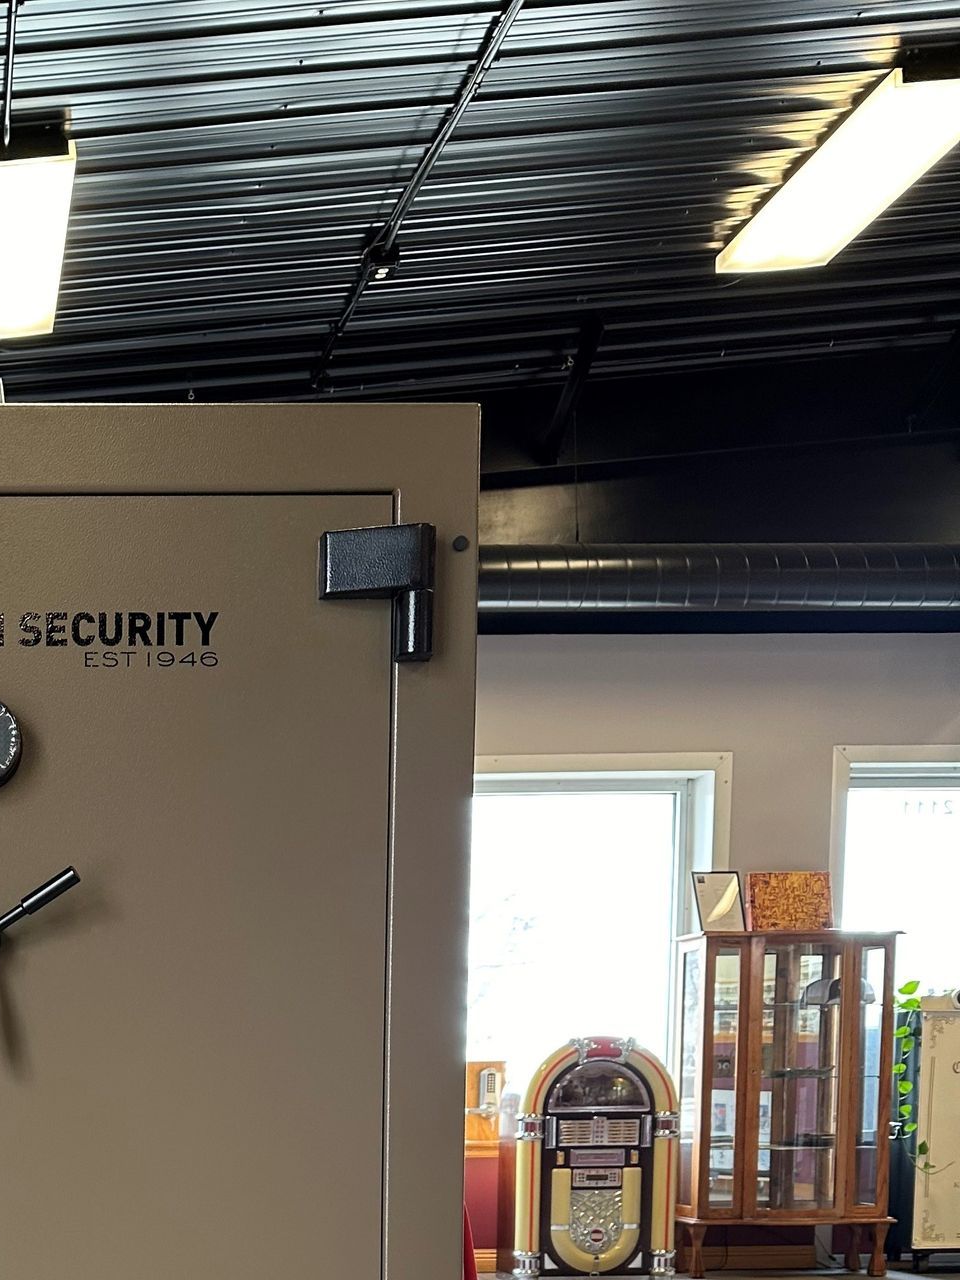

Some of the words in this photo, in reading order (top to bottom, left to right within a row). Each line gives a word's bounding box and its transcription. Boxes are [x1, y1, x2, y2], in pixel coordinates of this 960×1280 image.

[18, 612, 219, 647] SECURITY
[84, 651, 137, 668] EST
[147, 651, 219, 668] 1946
